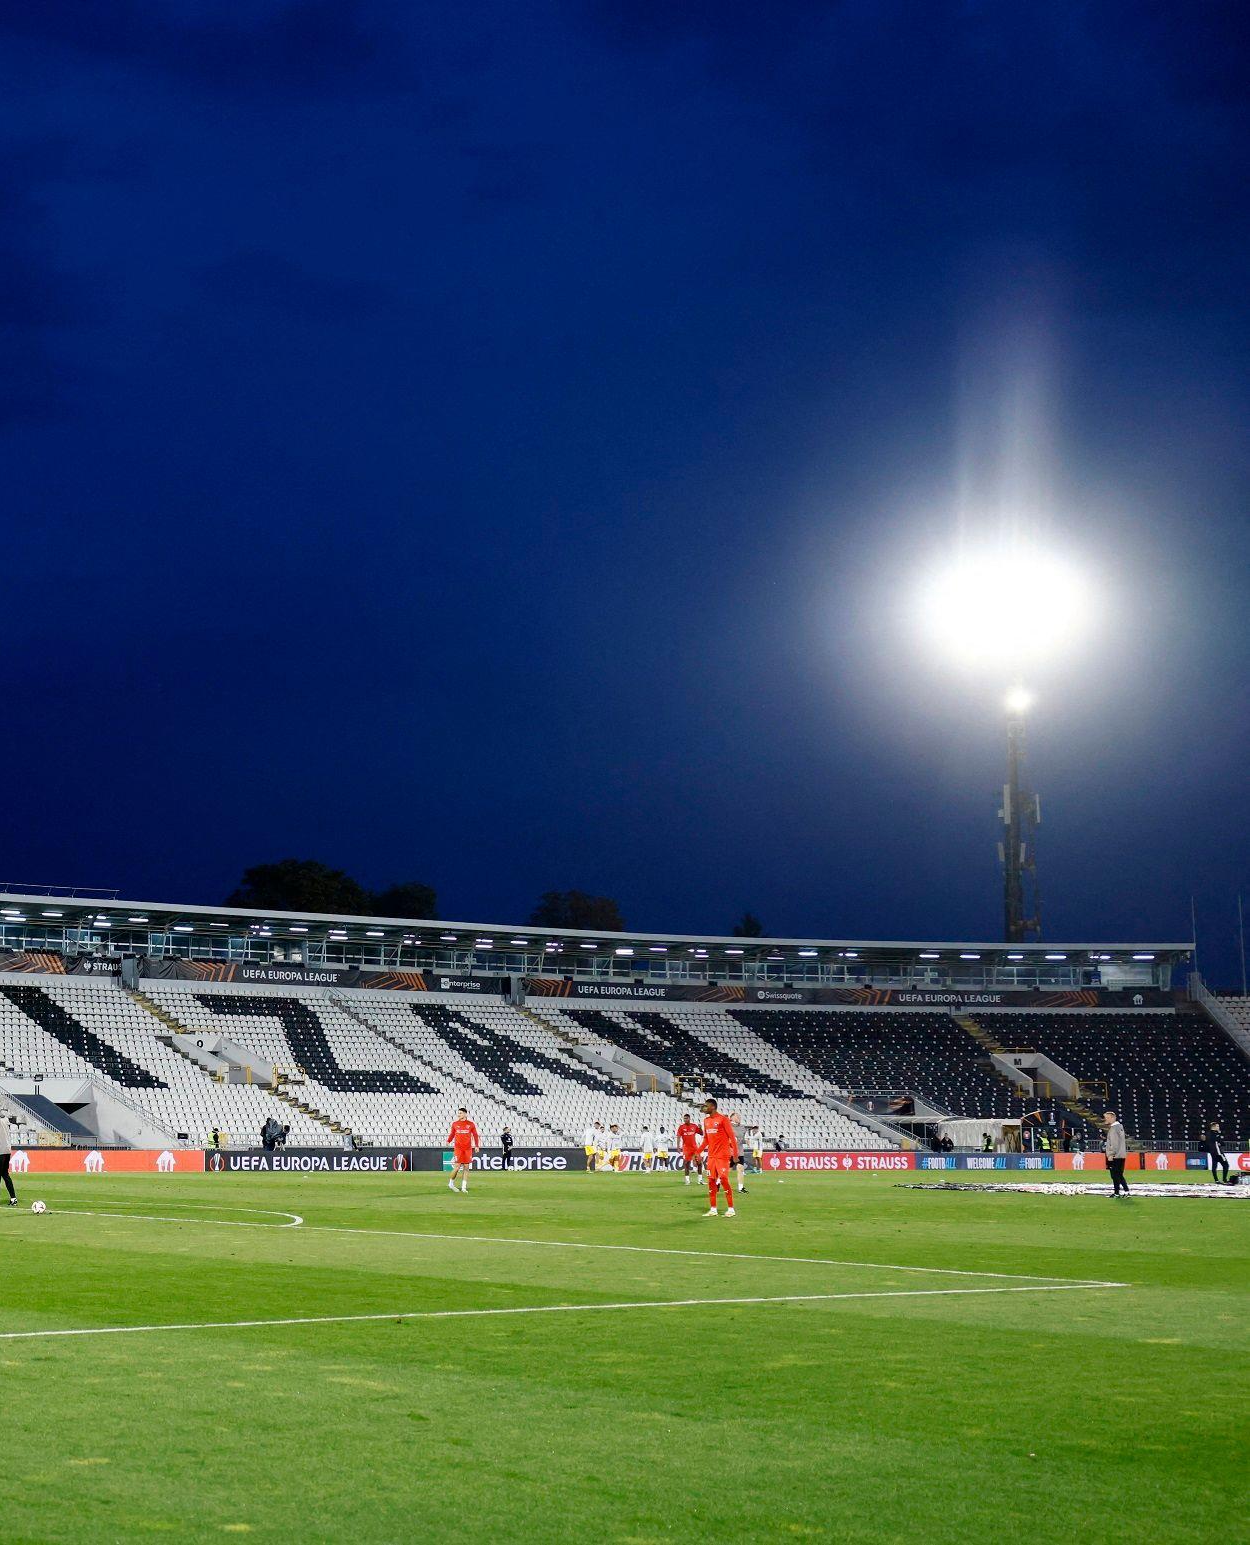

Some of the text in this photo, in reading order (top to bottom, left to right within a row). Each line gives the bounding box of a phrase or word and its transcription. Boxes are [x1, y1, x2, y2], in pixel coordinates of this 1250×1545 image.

[242, 969, 338, 983] UEFA EUROPA LEAGUE
[578, 985, 666, 997] UEFA EUROPA LEAGUE
[765, 991, 803, 1001] Swissquote
[898, 994, 1002, 1003] UEFA EUROPA LEAGUE
[230, 1156, 387, 1171] UEFA EUROPA LEAGUE
[785, 1156, 908, 1170] STRAUSS STRAUSS
[921, 1157, 957, 1169] #FOOTBALL
[966, 1157, 1006, 1169] WELCOME ALL
[1018, 1157, 1052, 1169] #FOOTBALL
